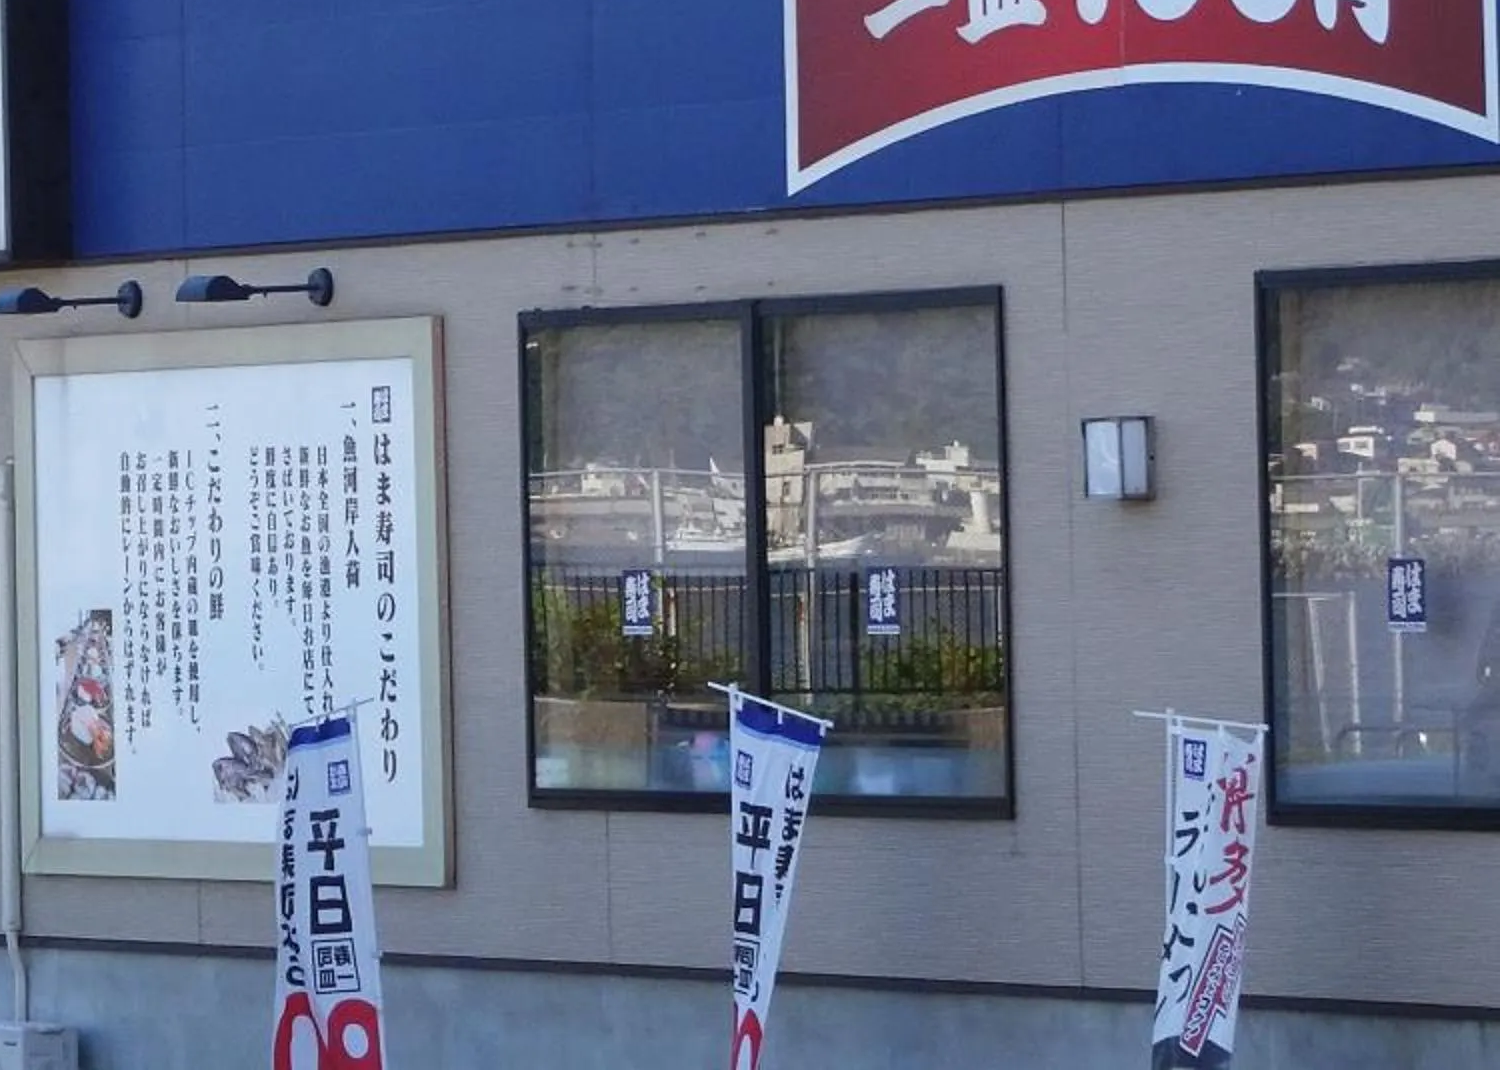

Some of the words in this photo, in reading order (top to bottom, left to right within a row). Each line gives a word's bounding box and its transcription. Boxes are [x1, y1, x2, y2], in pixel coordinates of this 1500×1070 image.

[317, 446, 334, 724] 日本全国の漁港より仕入れ
[373, 433, 399, 782] はま寿司のこだわり
